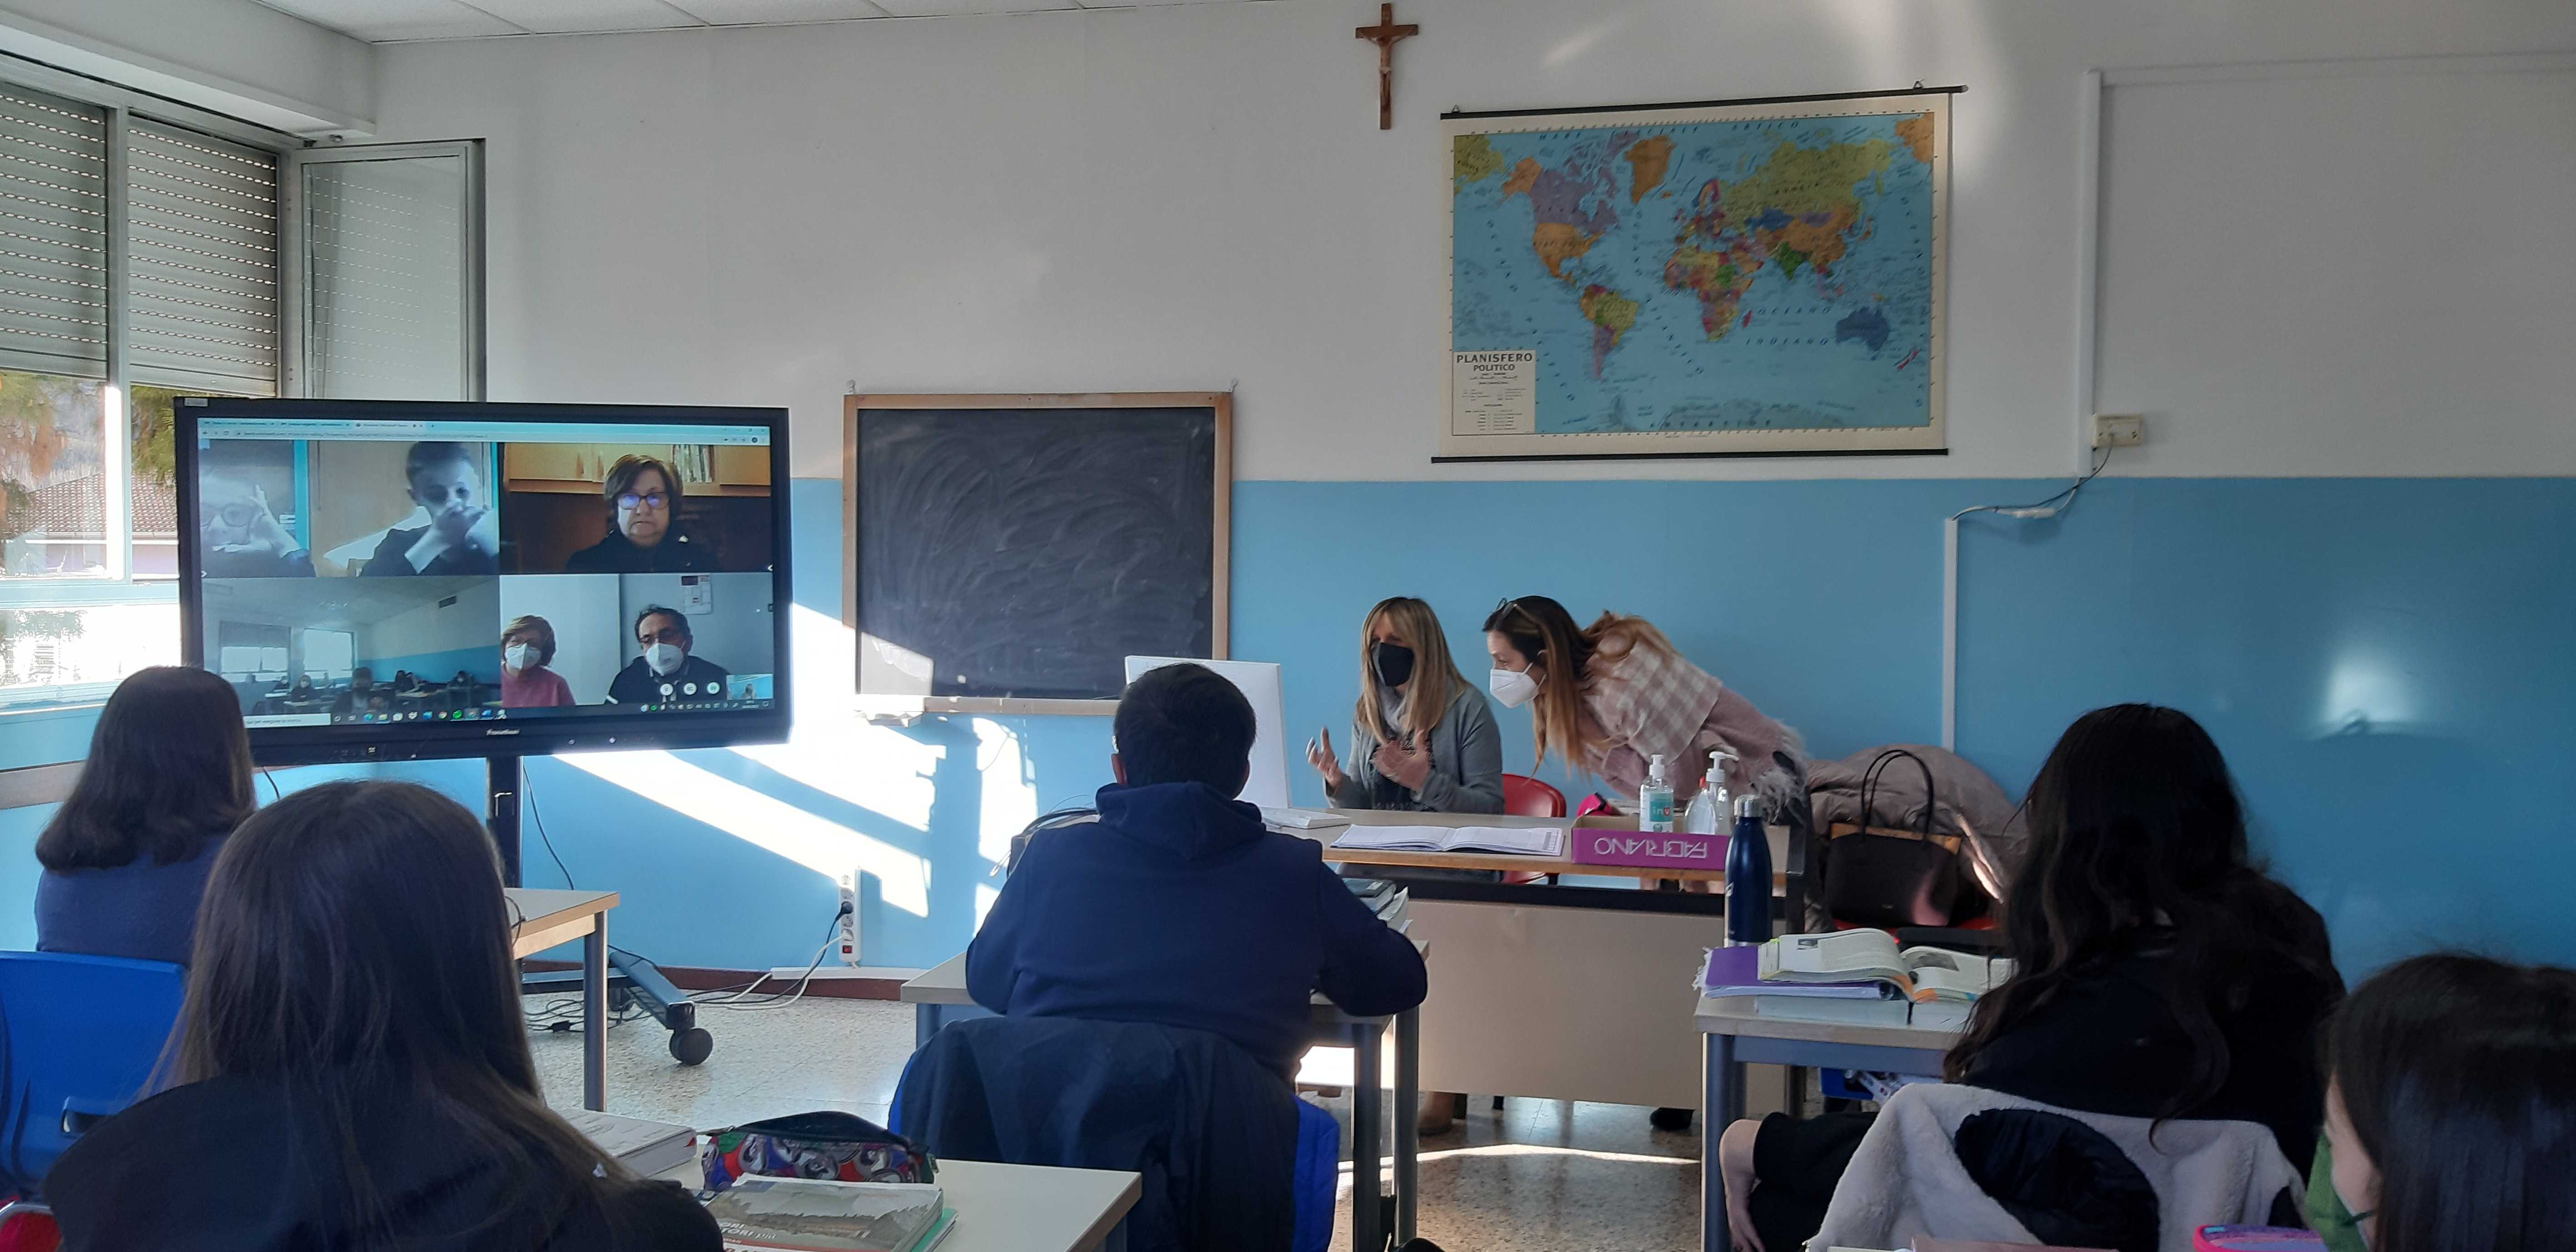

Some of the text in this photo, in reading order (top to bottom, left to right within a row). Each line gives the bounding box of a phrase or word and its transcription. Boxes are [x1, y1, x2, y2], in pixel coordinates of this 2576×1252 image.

[1457, 353, 1532, 363] PLANISFERO
[1594, 837, 1708, 859] FABRIANO
[720, 1227, 755, 1237] TORI
